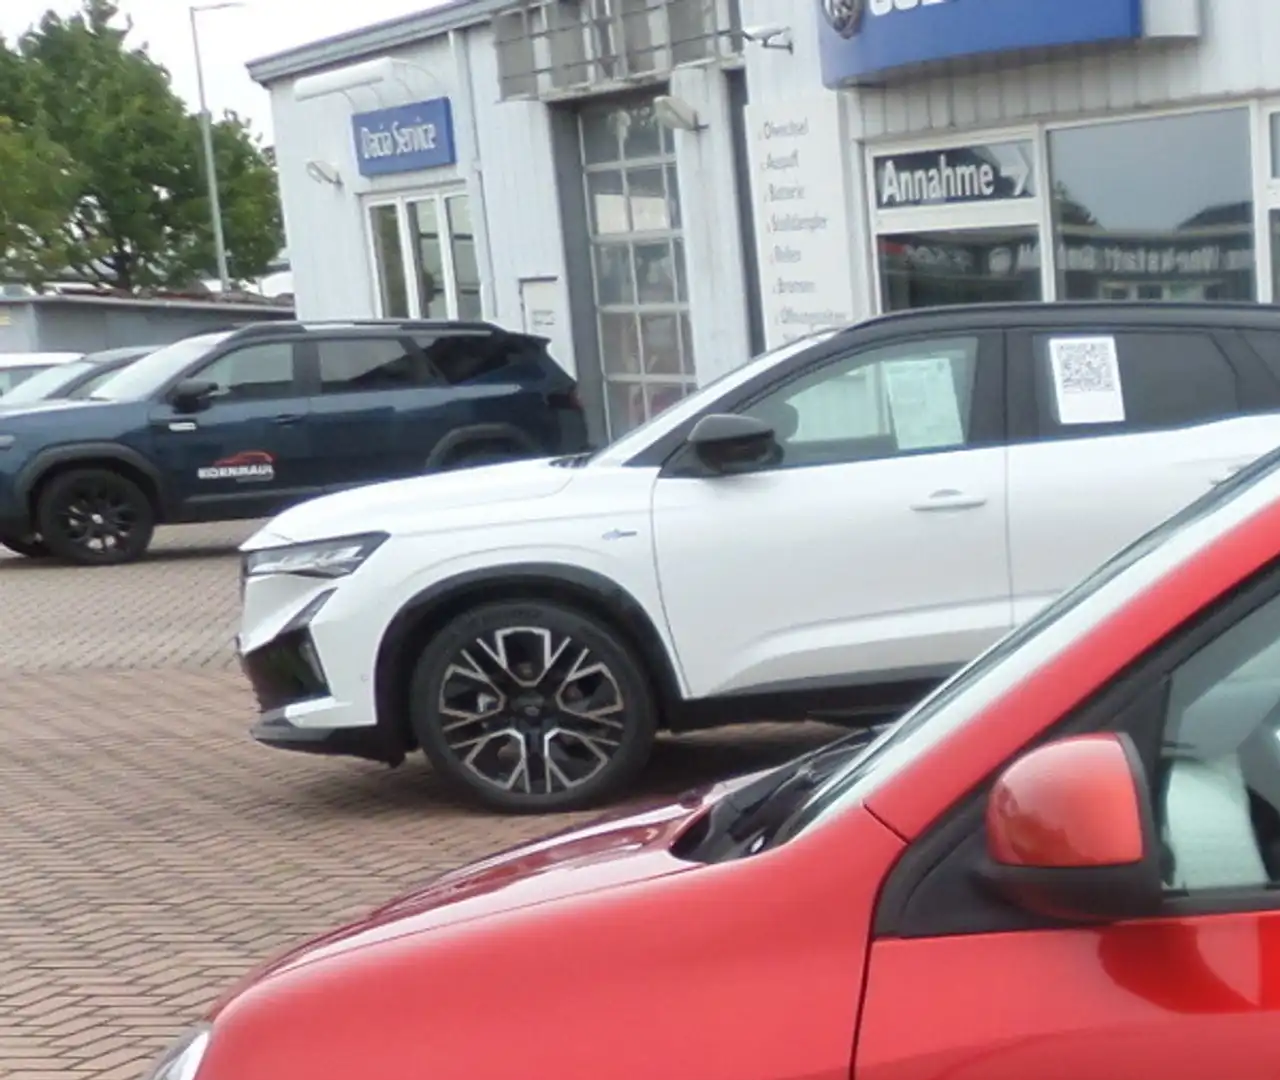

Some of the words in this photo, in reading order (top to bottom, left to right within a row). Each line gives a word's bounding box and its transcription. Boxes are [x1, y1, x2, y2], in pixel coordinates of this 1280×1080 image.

[361, 124, 393, 159] Dacia
[392, 116, 436, 155] Service
[882, 154, 995, 205] Annahme
